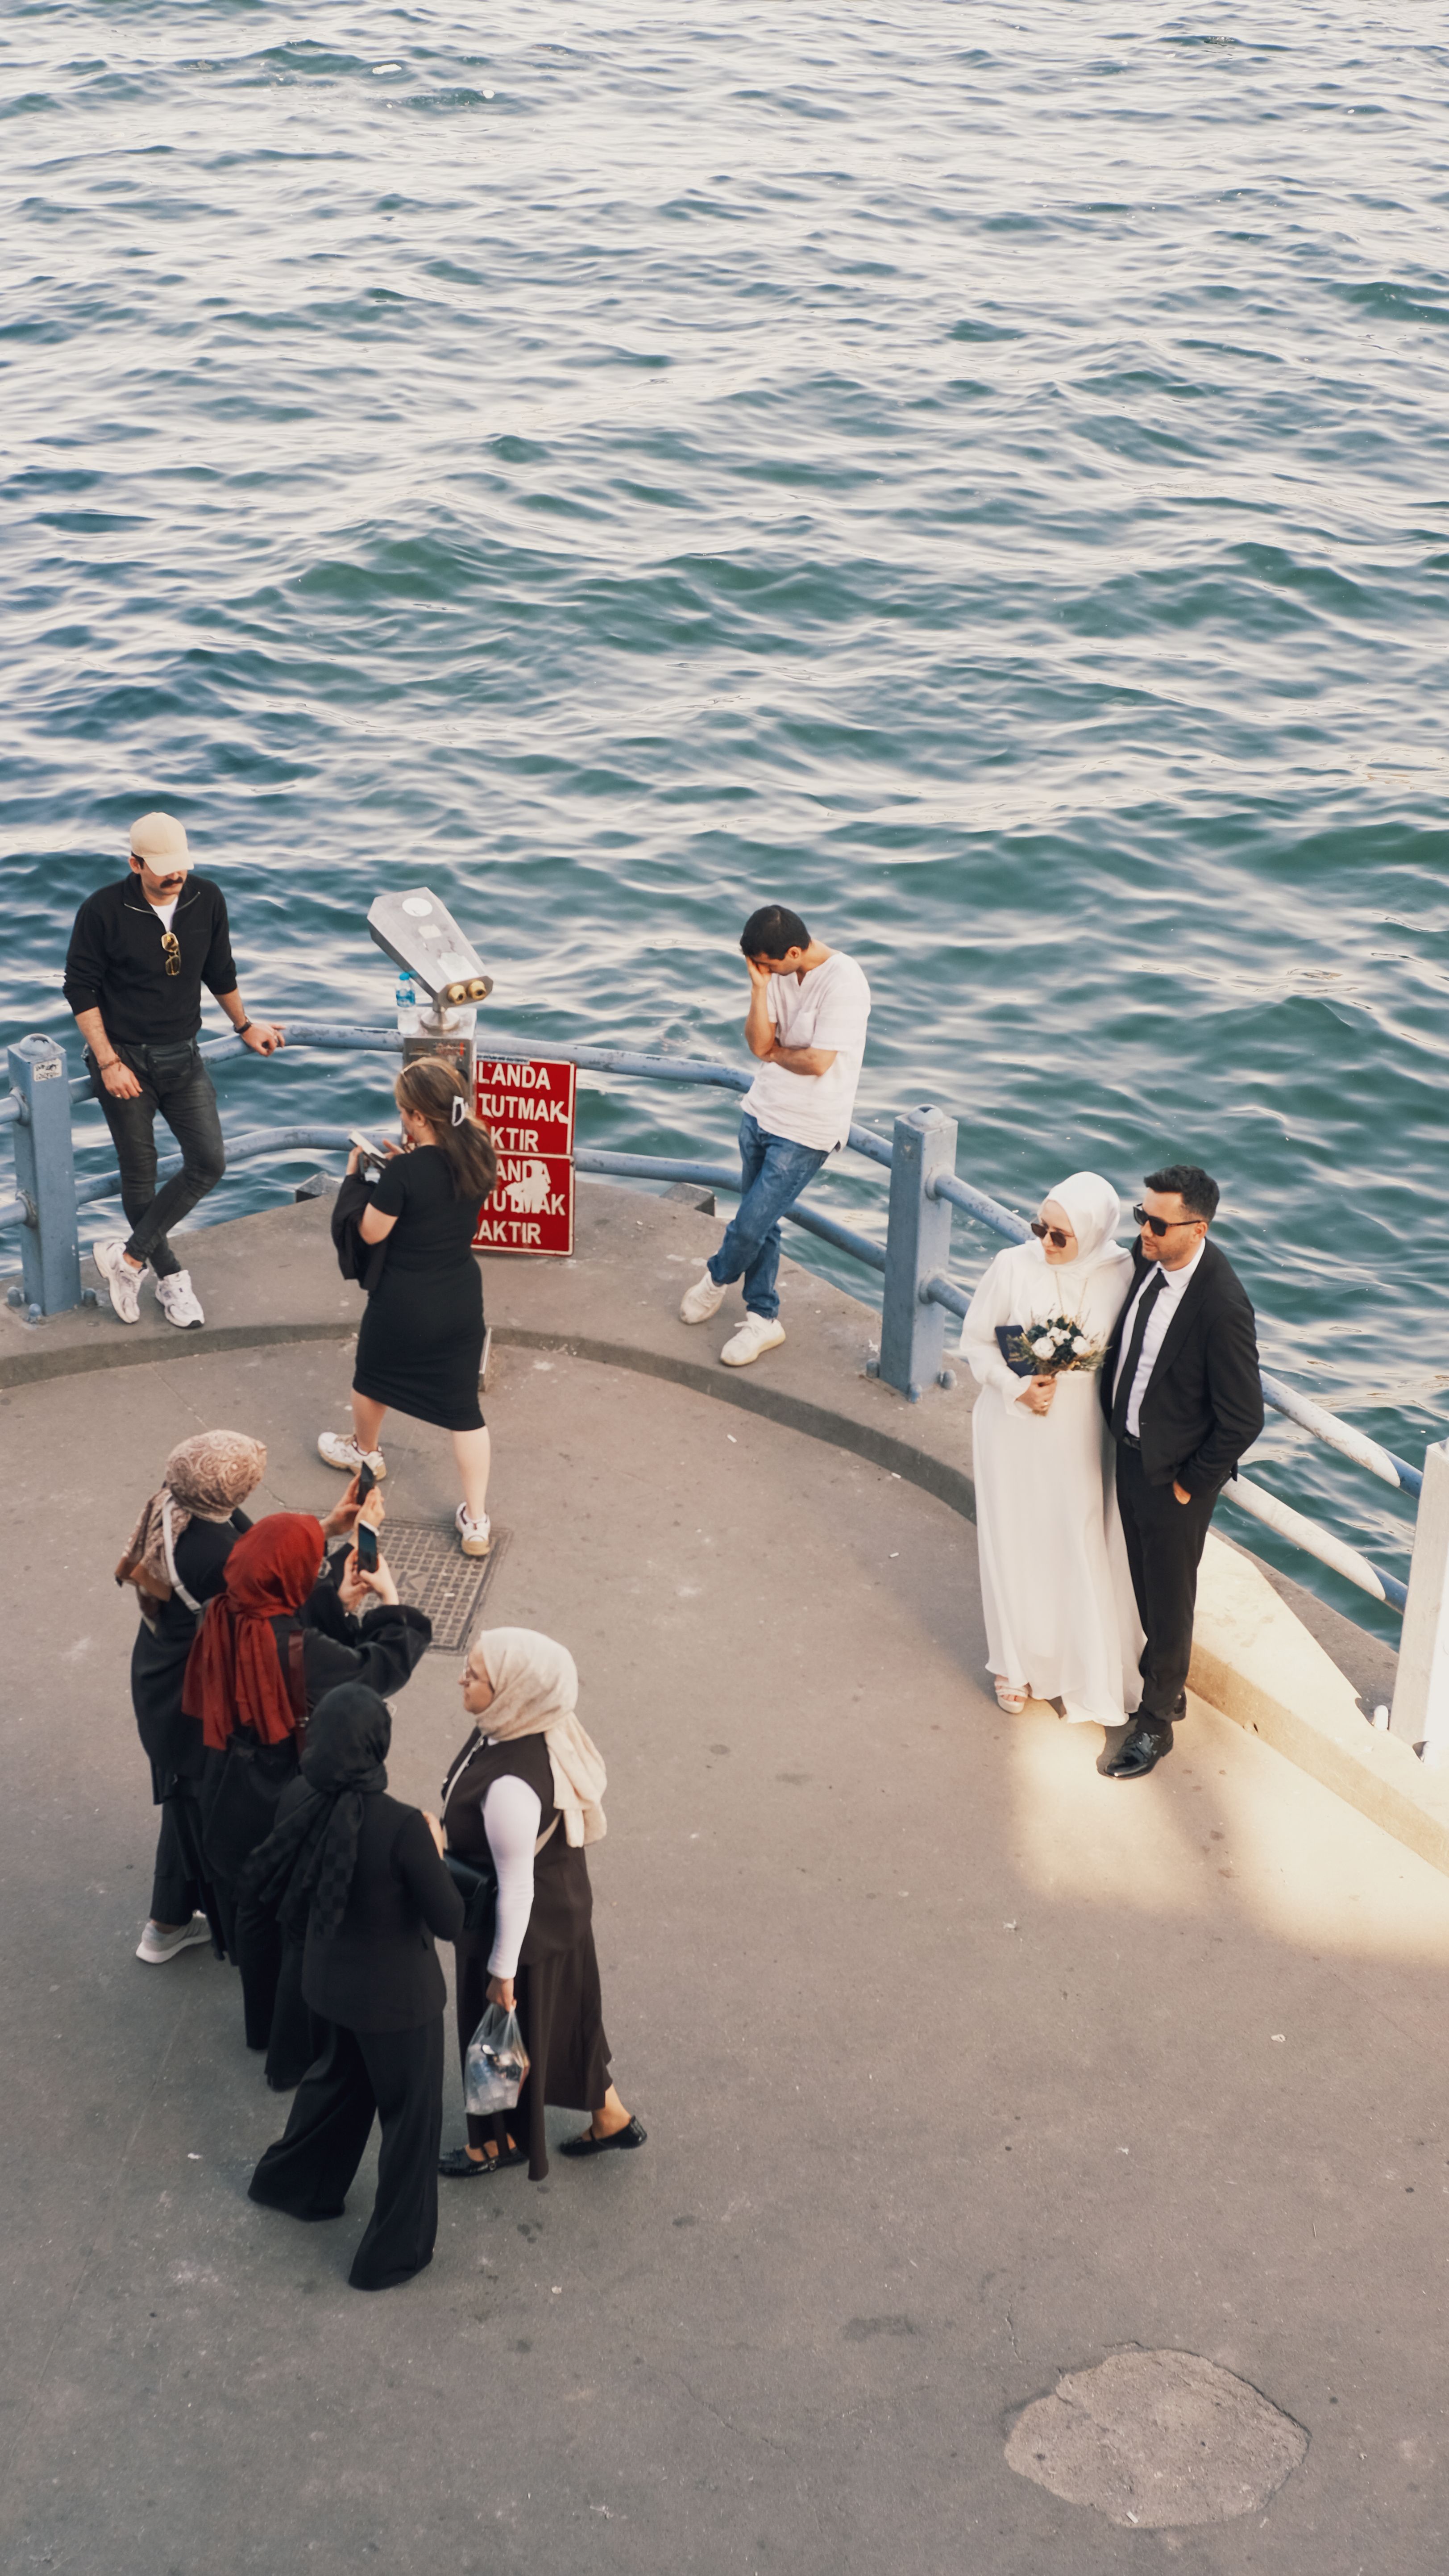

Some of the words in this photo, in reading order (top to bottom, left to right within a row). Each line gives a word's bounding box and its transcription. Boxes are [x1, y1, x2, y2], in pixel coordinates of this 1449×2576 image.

[478, 1061, 551, 1090] LANDA
[478, 1093, 565, 1123] TUTMAK
[491, 1126, 539, 1152] KTIR
[496, 1159, 551, 1184] ANDA
[473, 1219, 541, 1244] AKTIR
